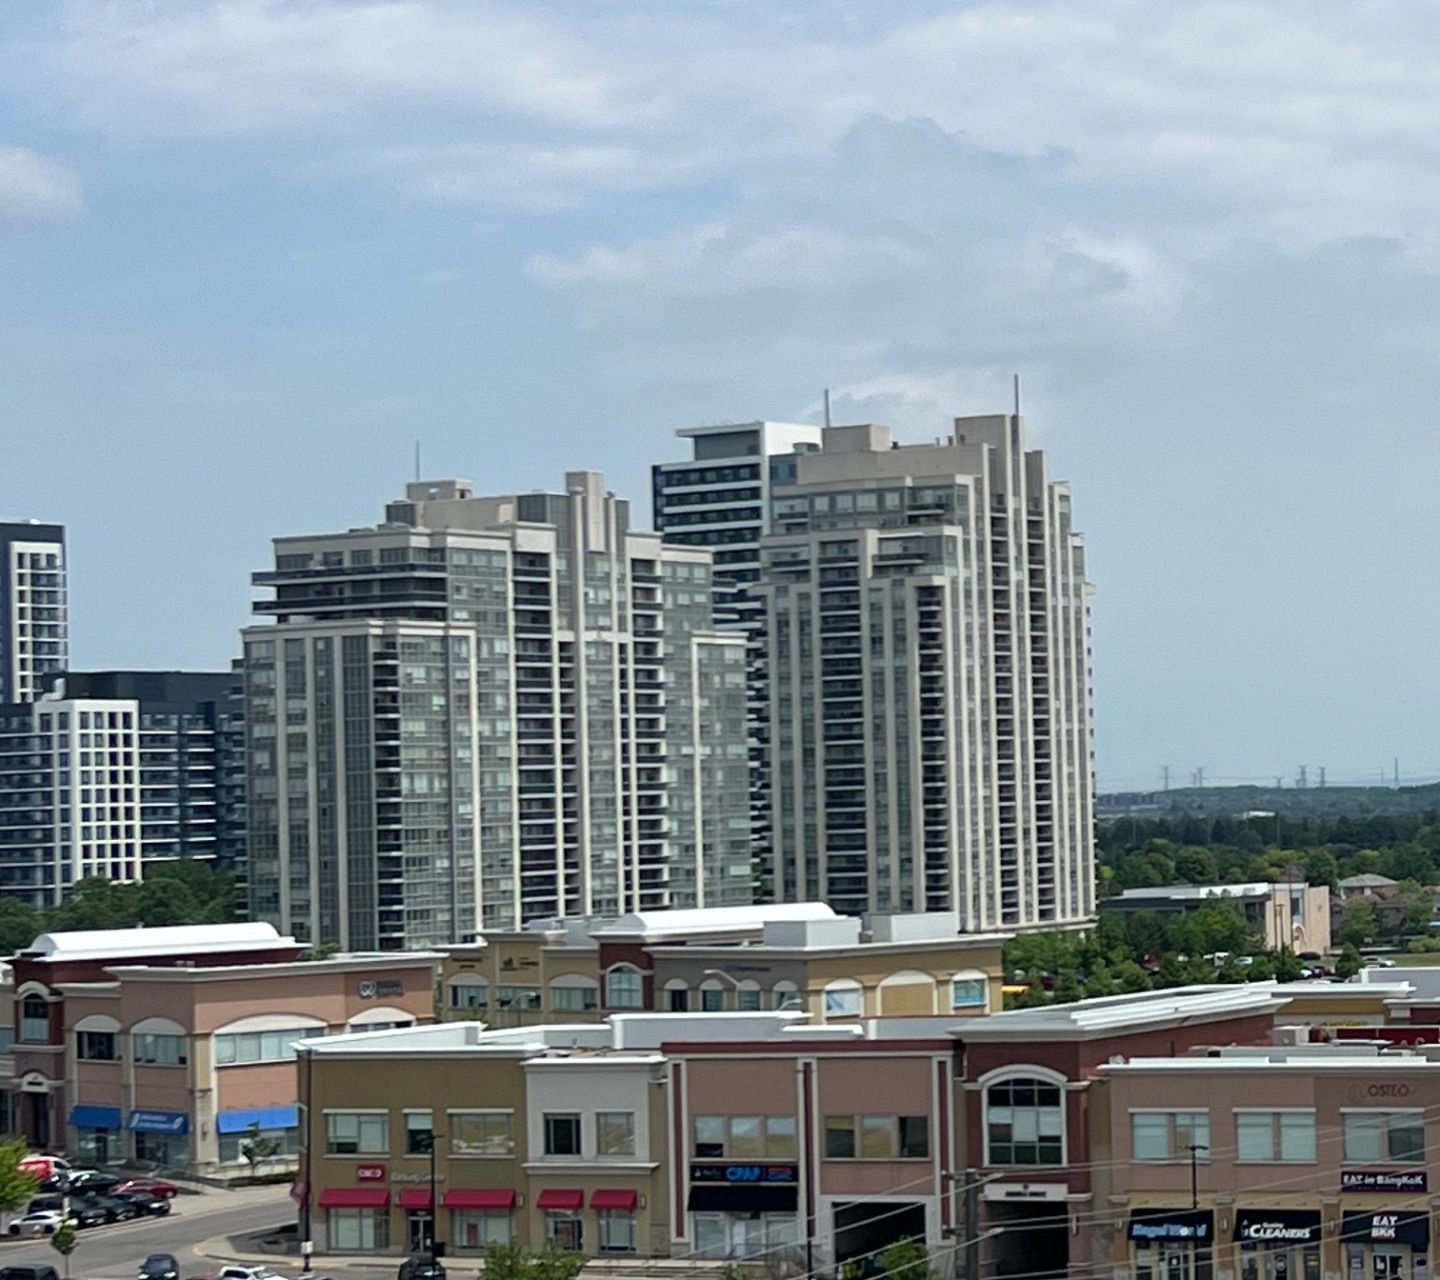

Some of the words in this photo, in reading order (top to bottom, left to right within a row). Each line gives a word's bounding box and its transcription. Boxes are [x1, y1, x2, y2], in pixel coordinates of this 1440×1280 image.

[1367, 1084, 1409, 1097] OSTEO
[1373, 1215, 1398, 1226] EAT
[1249, 1224, 1310, 1238] CLEANERS
